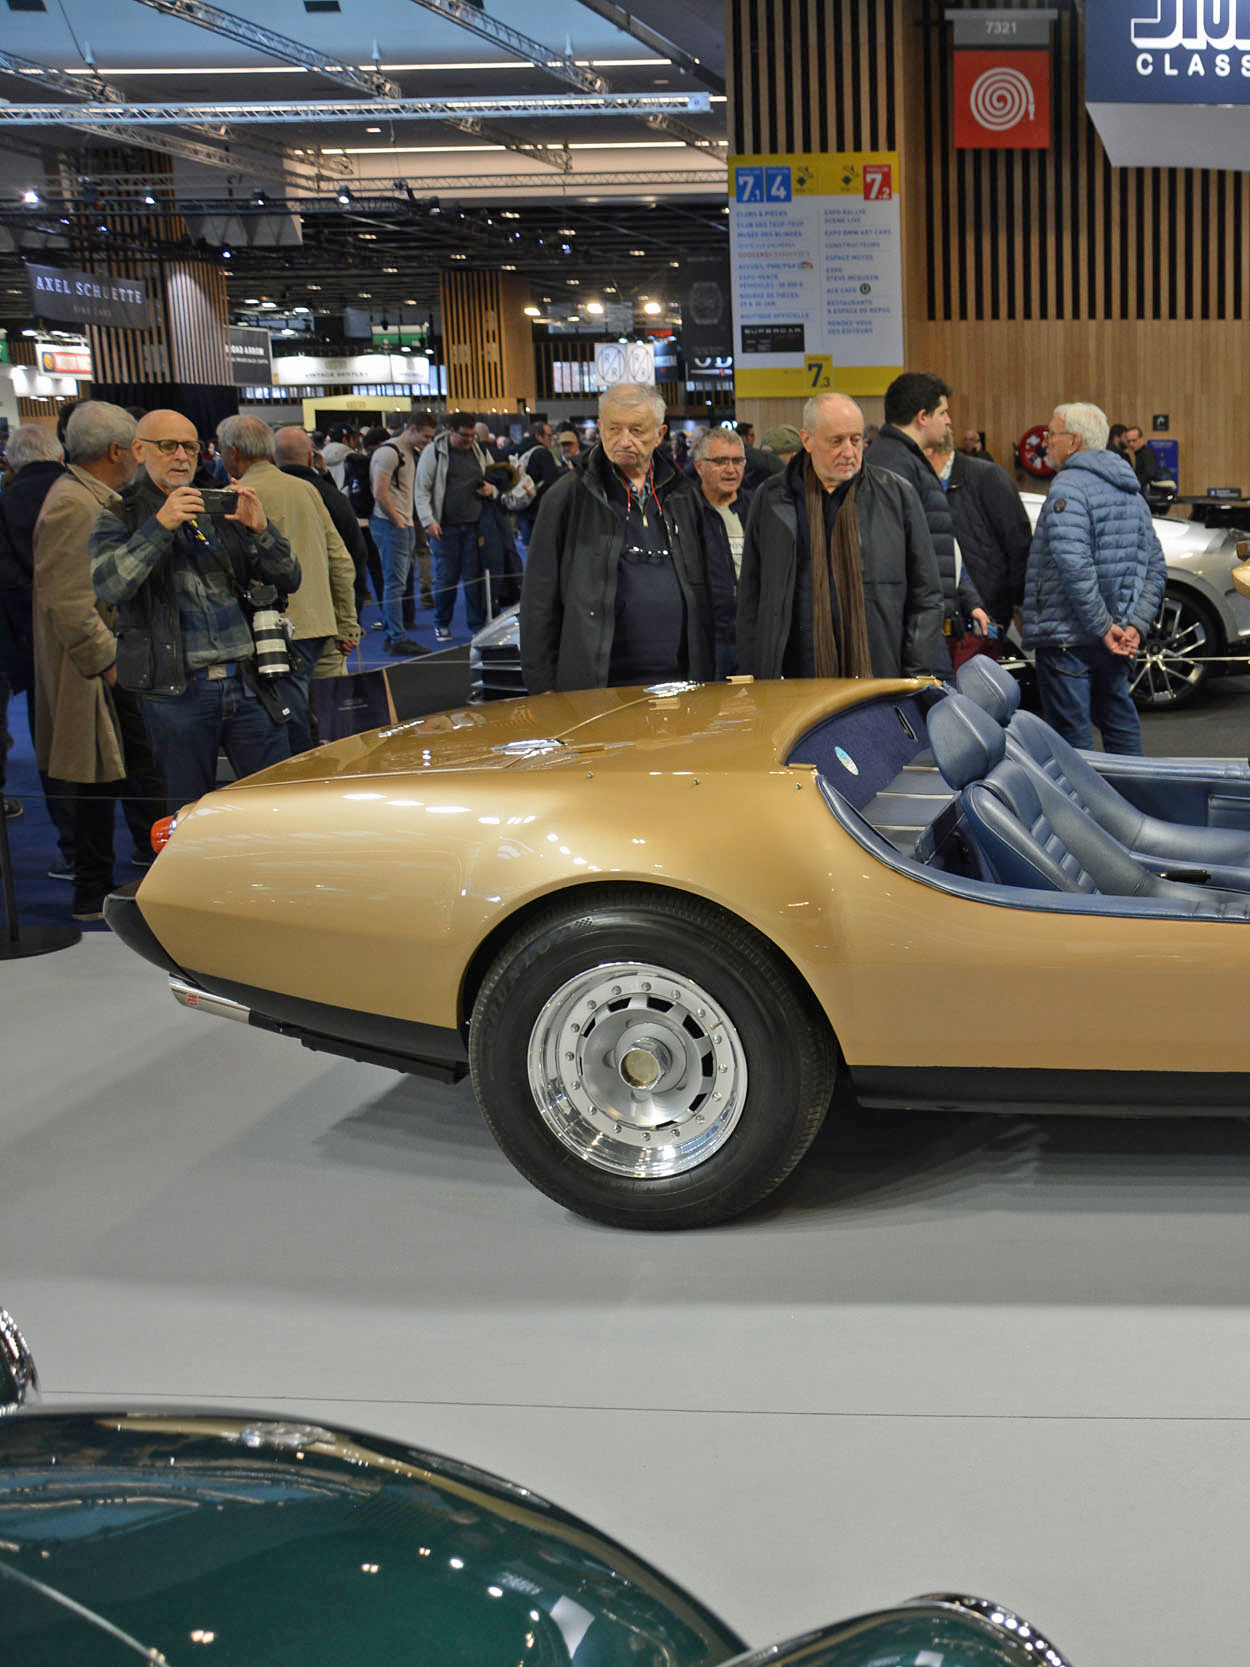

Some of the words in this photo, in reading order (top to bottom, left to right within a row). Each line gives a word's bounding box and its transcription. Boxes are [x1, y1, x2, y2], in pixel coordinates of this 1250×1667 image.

[985, 21, 1016, 34] 7321
[771, 175, 787, 199] 4
[36, 275, 72, 295] AXEL
[75, 281, 143, 304] SCHUETTE
